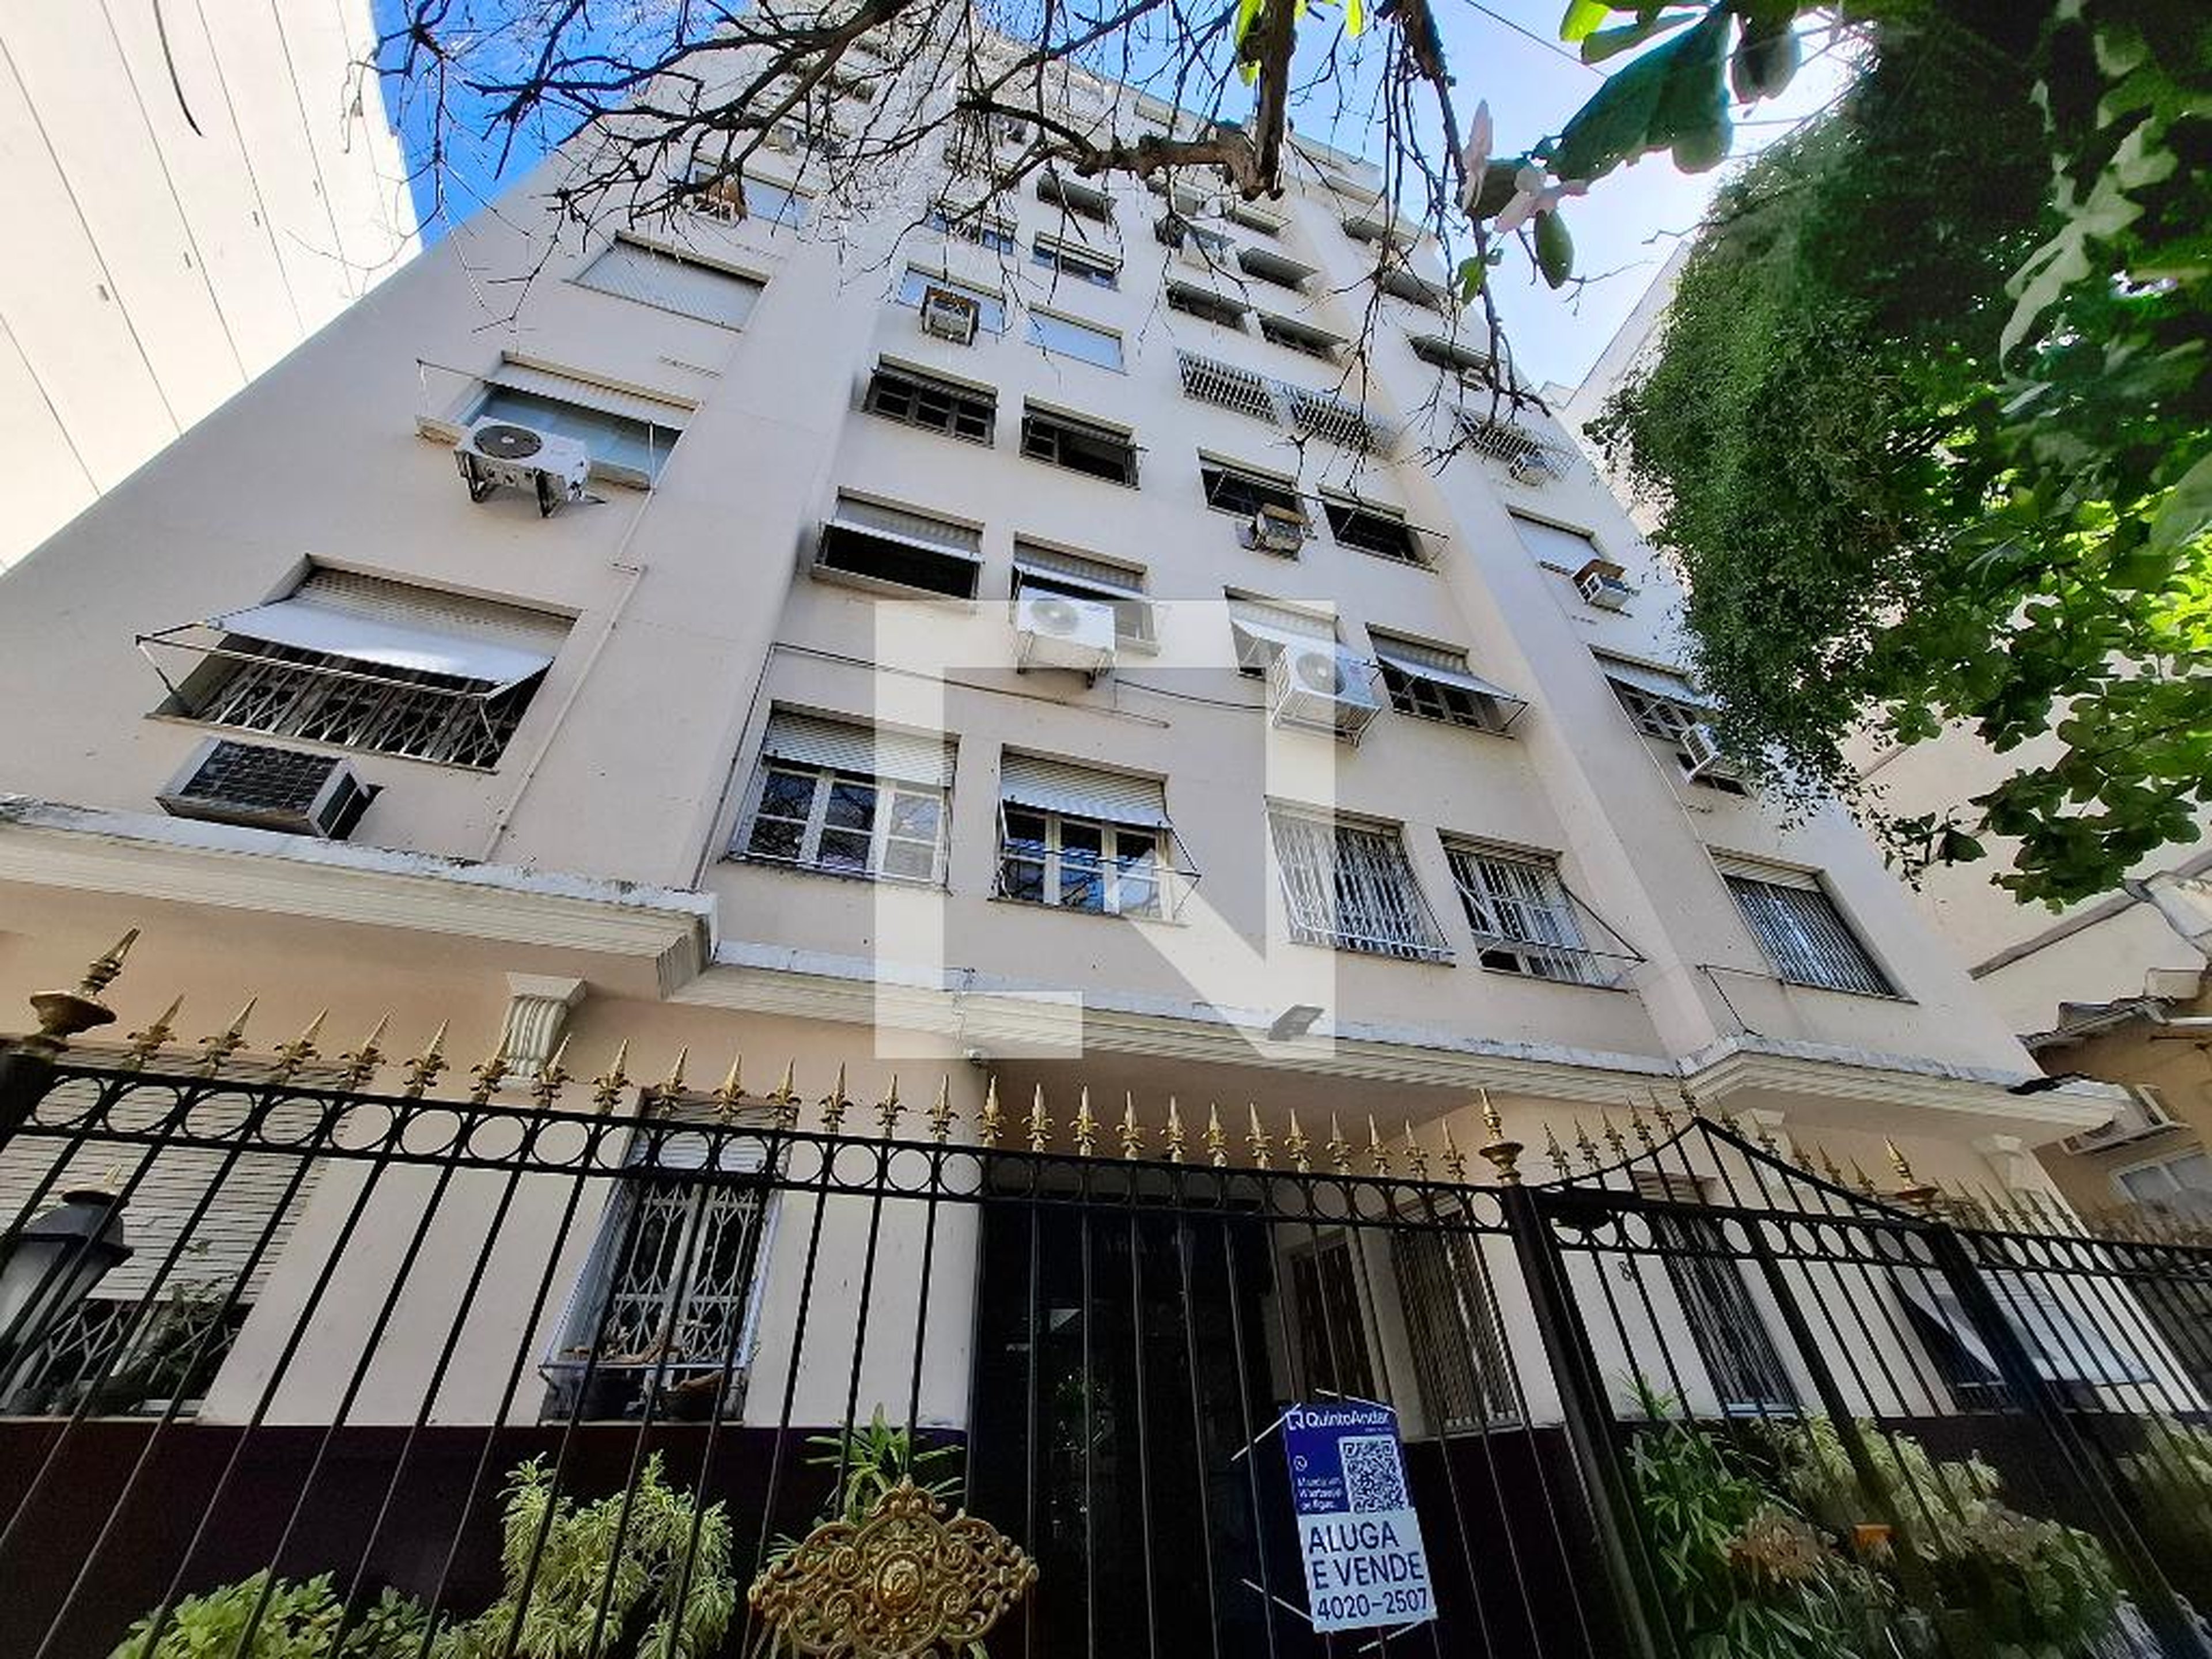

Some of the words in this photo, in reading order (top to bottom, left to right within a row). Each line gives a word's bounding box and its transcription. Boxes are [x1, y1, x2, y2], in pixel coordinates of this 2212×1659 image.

[1306, 1411, 1389, 1427] QuintoAndar
[1309, 1521, 1400, 1554] ALUGA
[1312, 1560, 1329, 1590] E
[1333, 1552, 1425, 1586] VENDE
[1317, 1588, 1427, 1620] 4020-2507
